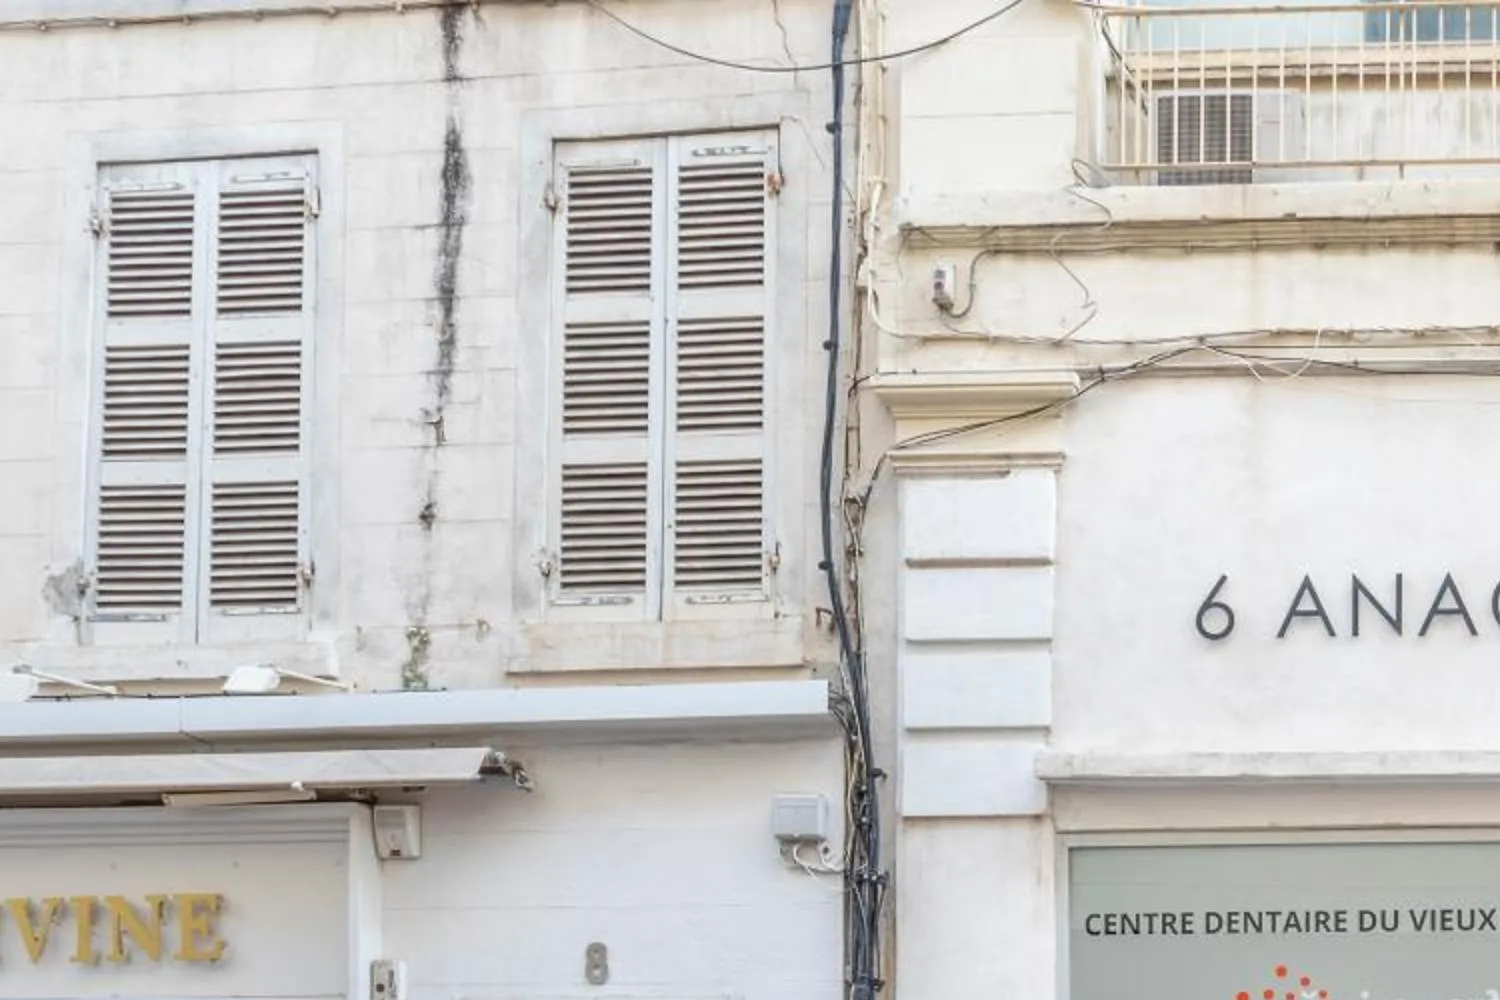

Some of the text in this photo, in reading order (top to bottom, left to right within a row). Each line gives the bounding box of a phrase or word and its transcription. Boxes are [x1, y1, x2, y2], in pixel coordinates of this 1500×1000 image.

[1194, 574, 1236, 641] 6
[0, 893, 228, 965] VINE
[1084, 911, 1195, 936] CENTRE
[1204, 909, 1348, 935] DENTAIRE
[1358, 908, 1400, 933] DU
[1409, 908, 1497, 932] VIEUX
[585, 941, 609, 986] 8
